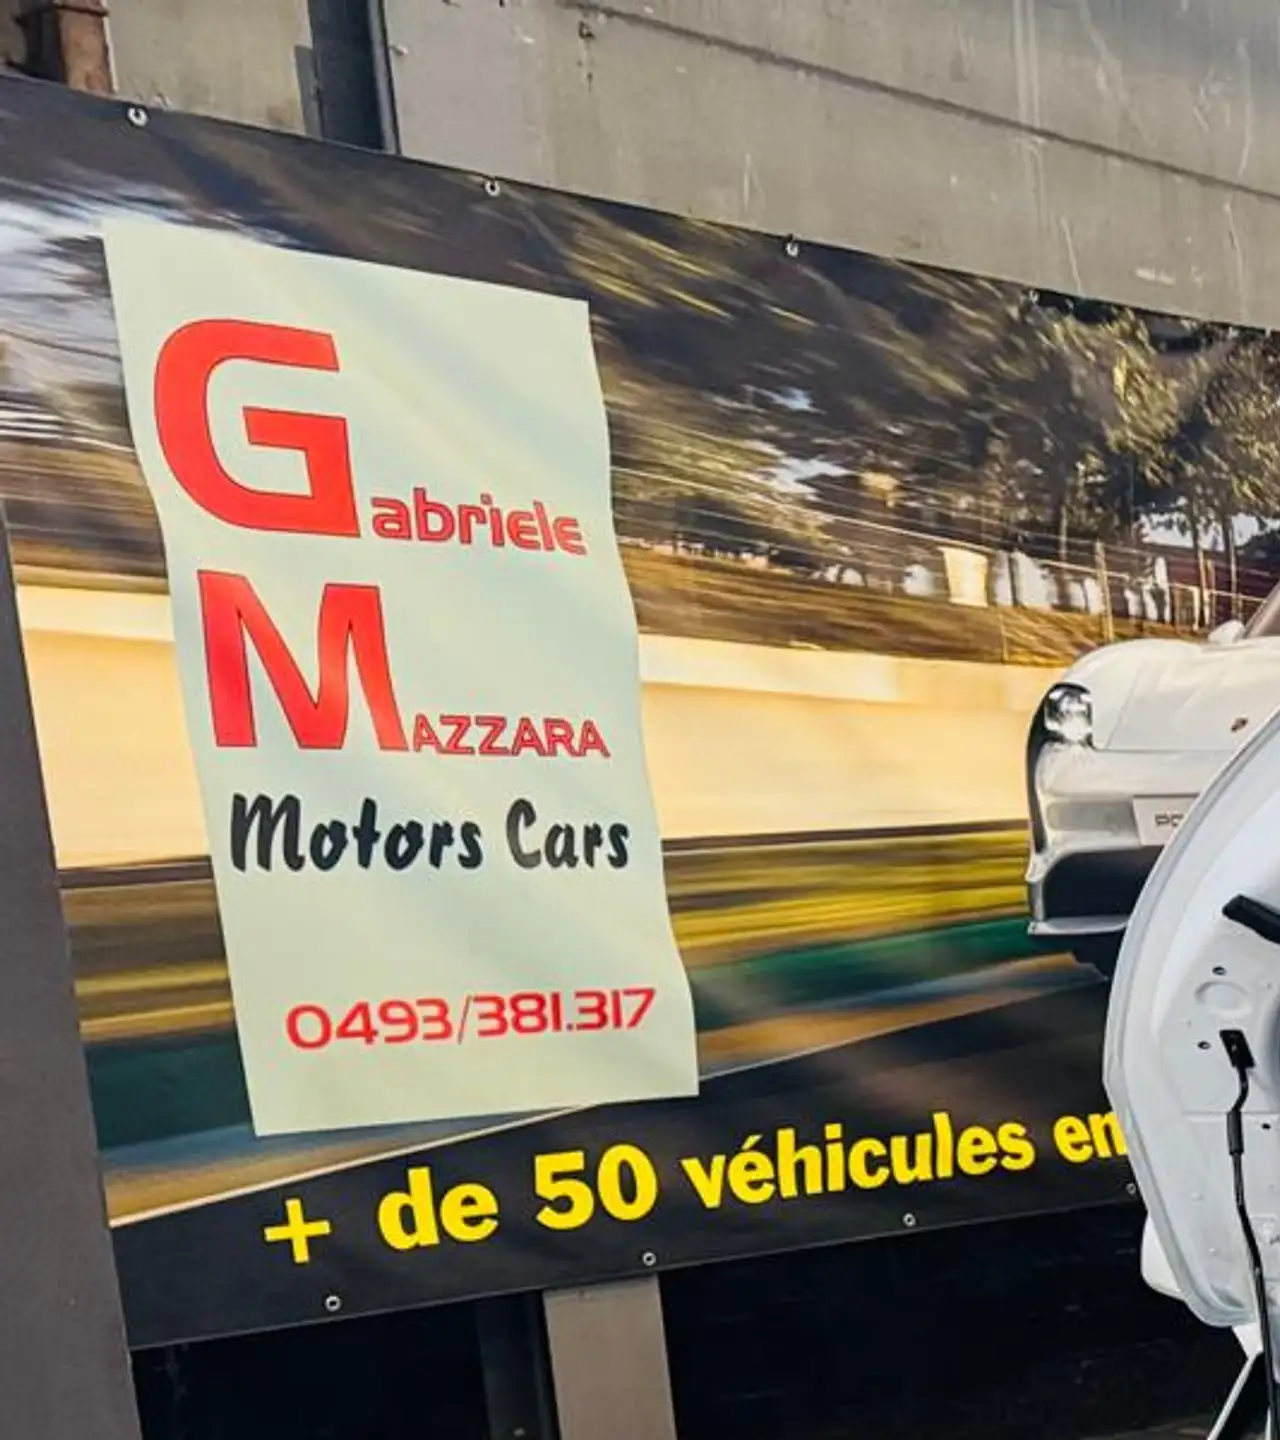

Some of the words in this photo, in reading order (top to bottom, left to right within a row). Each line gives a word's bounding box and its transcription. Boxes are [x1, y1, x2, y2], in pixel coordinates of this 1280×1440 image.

[153, 318, 587, 556] Gabriele
[230, 793, 483, 871] Motors
[505, 798, 630, 870] Cars
[285, 988, 656, 1050] 0493/381.317
[377, 1166, 500, 1250] de
[535, 1143, 658, 1230] 50
[680, 1112, 1036, 1209] véhicules
